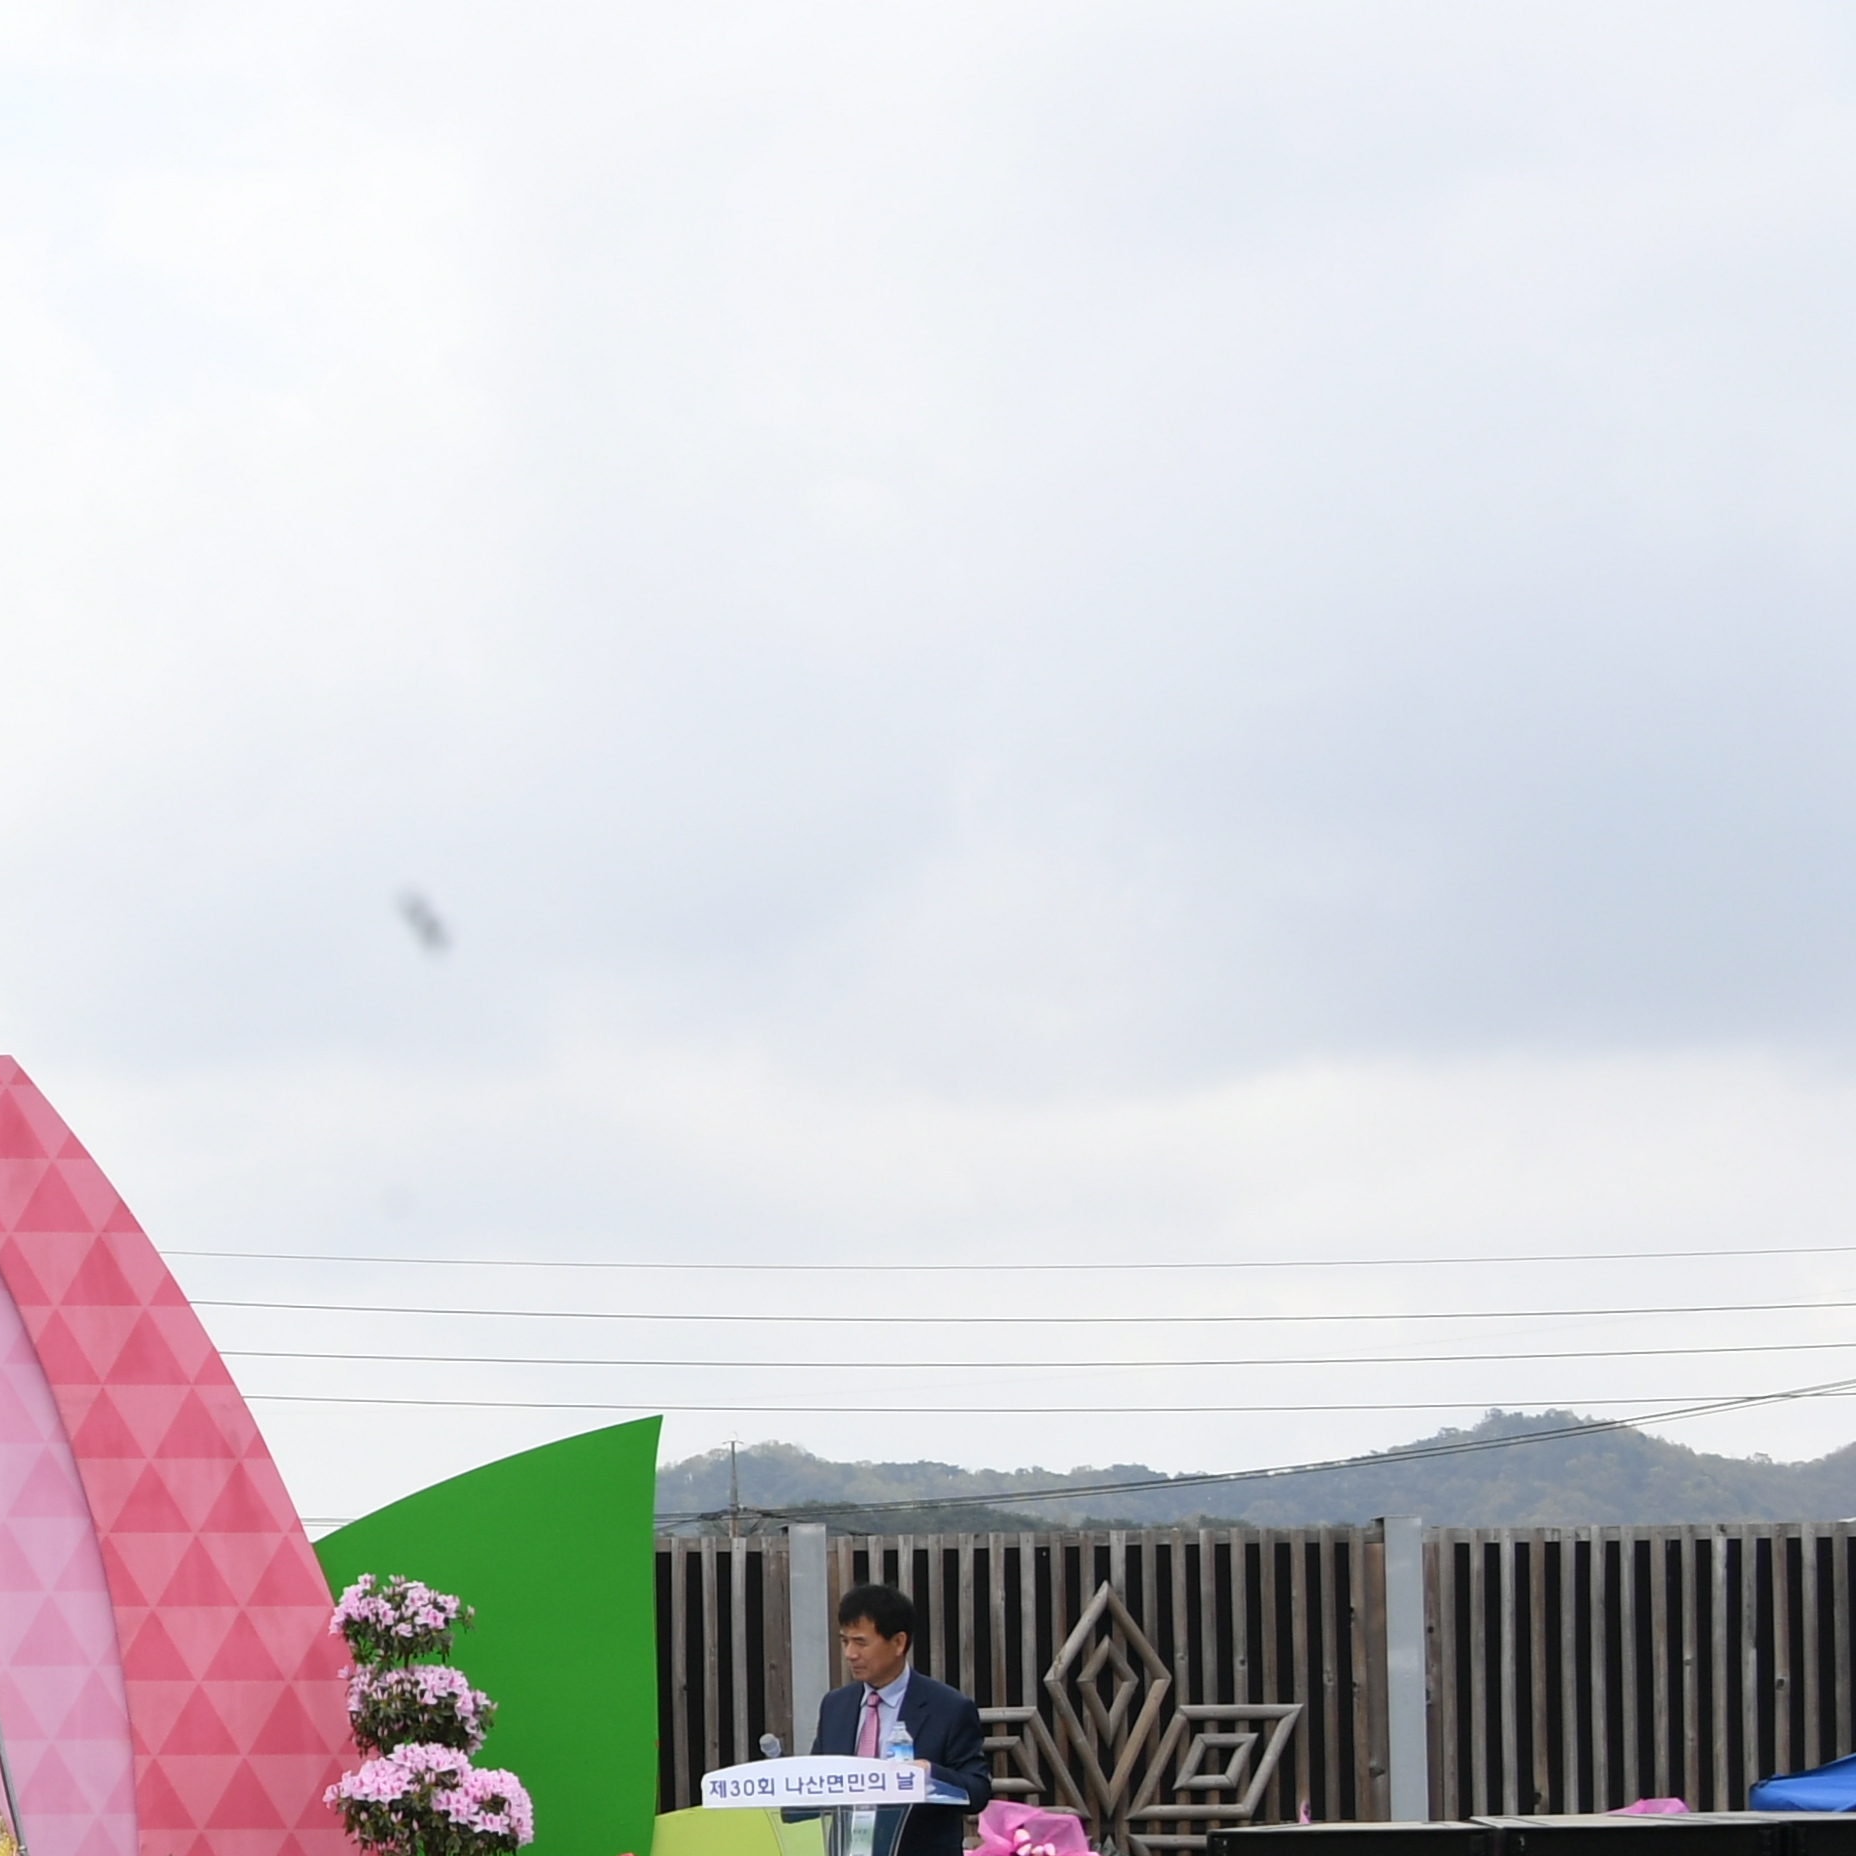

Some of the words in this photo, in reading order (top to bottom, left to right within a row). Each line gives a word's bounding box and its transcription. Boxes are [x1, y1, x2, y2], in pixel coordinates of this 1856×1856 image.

[710, 1777, 775, 1798] 제30회
[785, 1772, 886, 1794] 나산면민의
[896, 1771, 915, 1791] 날
